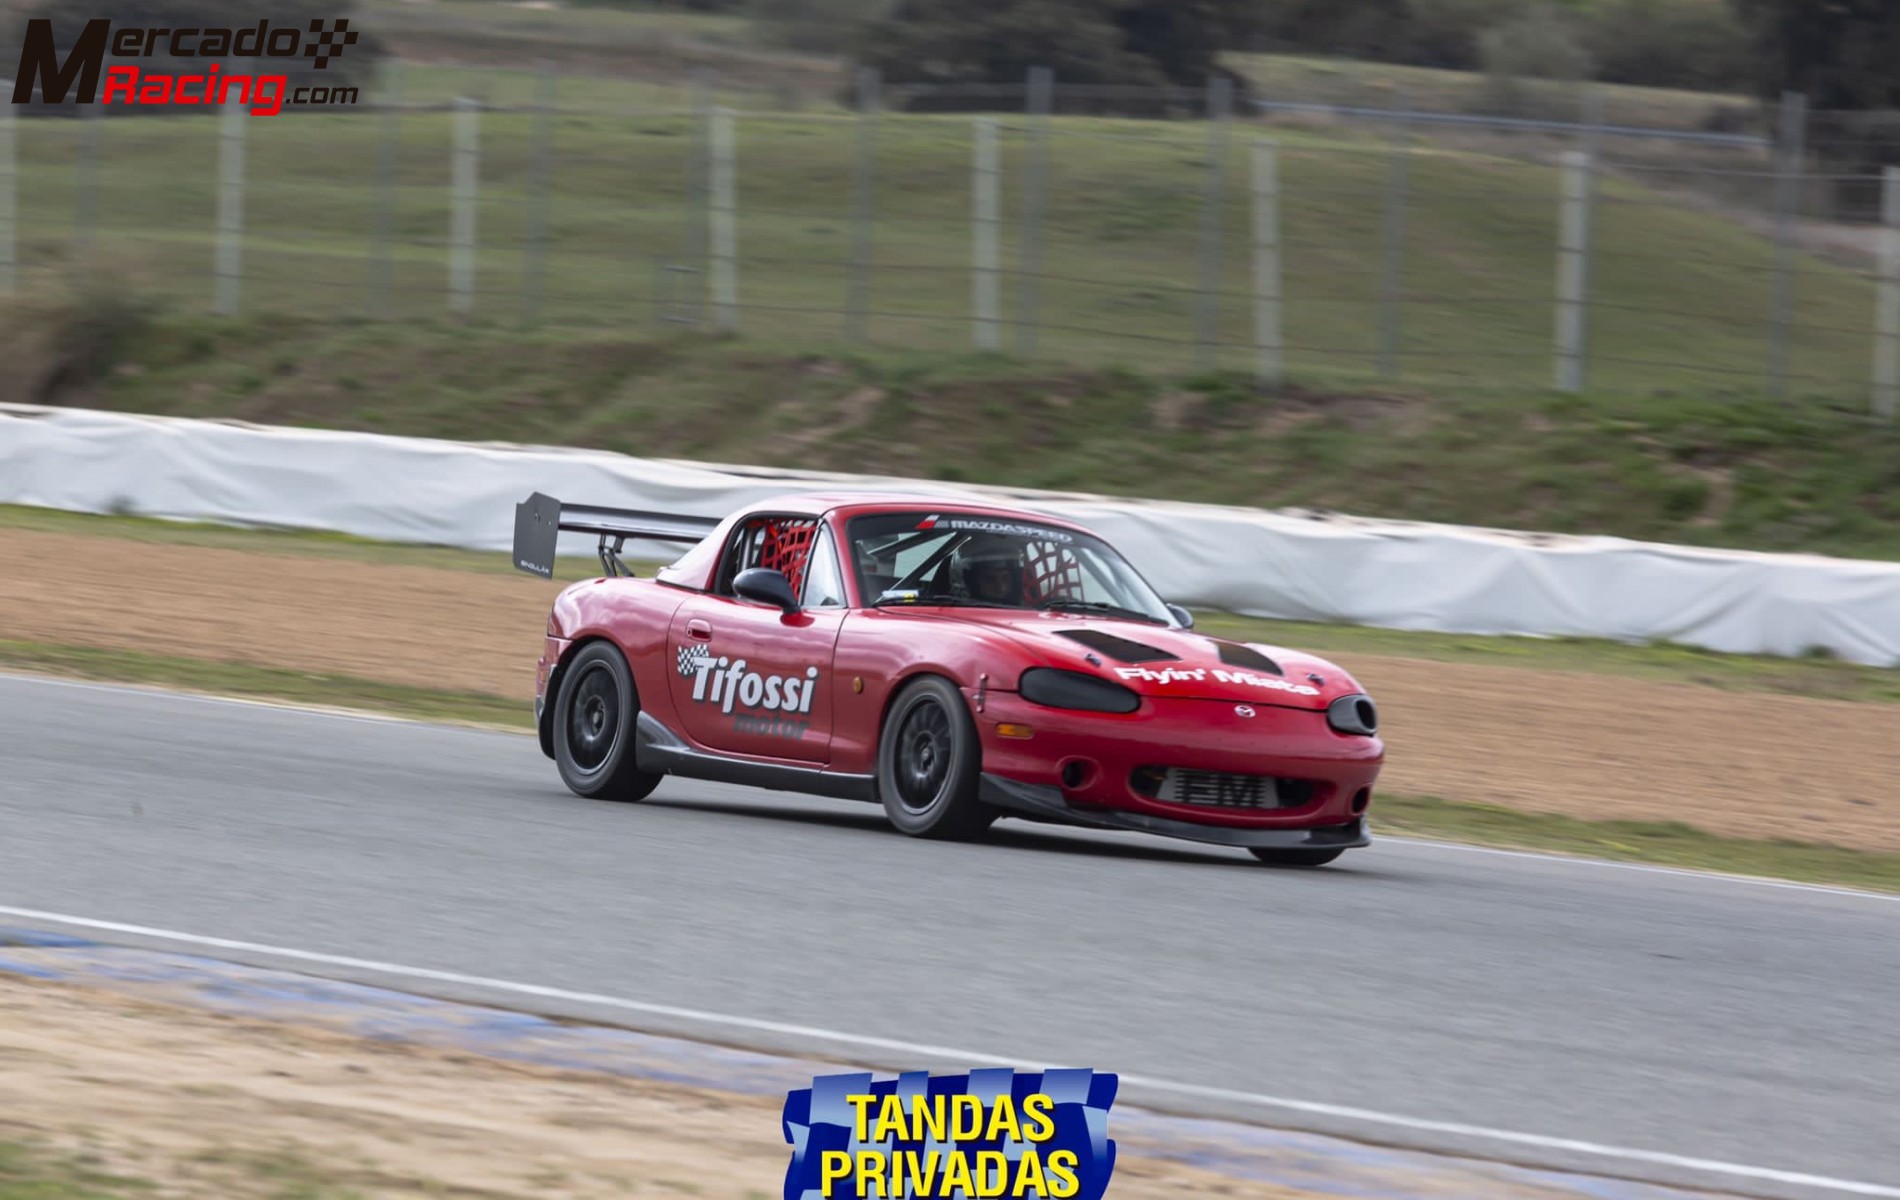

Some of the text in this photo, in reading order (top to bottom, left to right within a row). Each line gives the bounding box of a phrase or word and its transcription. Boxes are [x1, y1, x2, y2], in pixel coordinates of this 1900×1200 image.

[951, 520, 1073, 543] MAZDASPEED
[692, 656, 818, 713] Tifossi
[733, 713, 810, 741] motor
